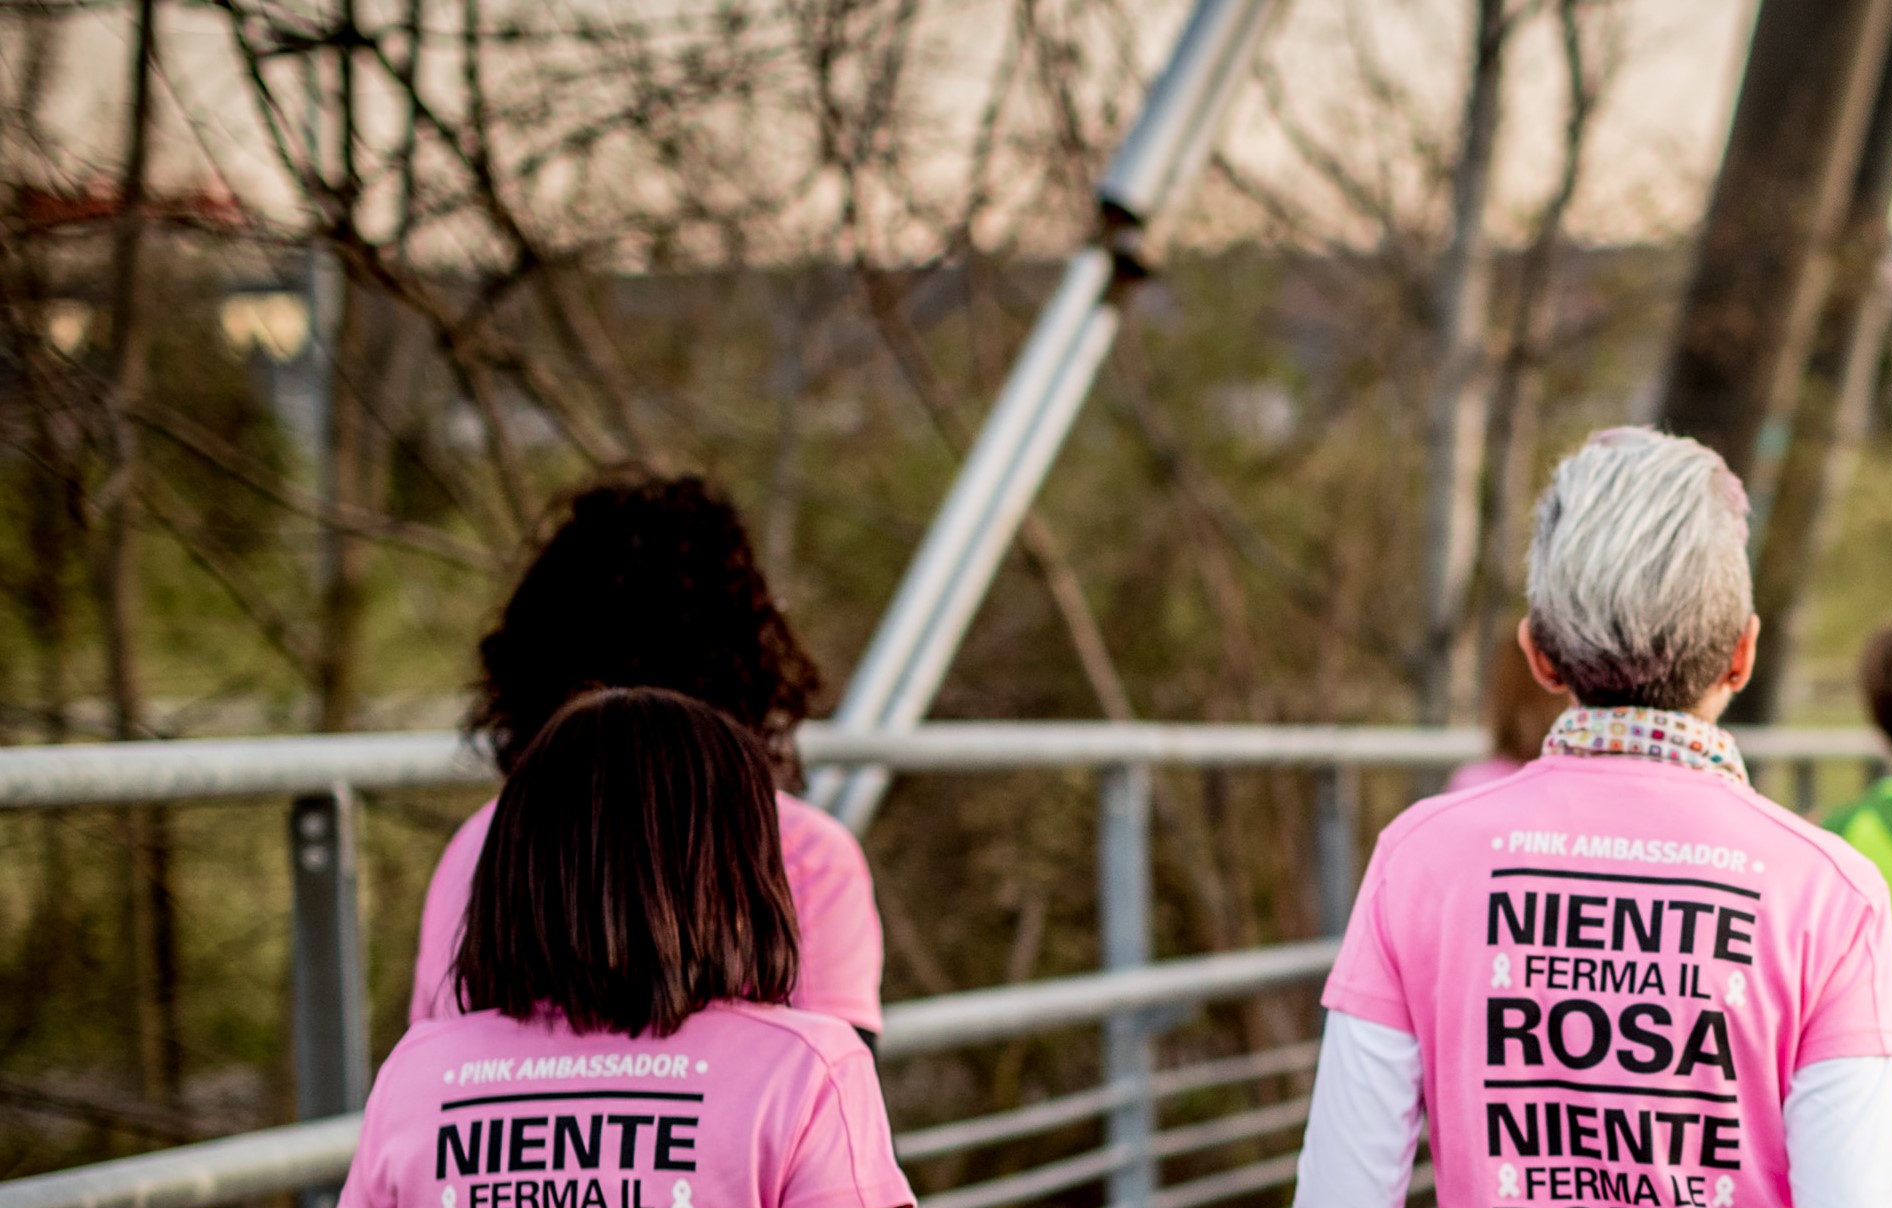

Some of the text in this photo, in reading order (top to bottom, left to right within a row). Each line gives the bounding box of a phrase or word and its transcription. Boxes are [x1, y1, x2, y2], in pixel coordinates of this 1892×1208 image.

[1509, 831, 1747, 872] PINK AMBASSADOR
[1487, 891, 1756, 966] NIENTE
[1525, 956, 1711, 1000] FERMA IL
[1486, 997, 1737, 1081] ROSA
[459, 1054, 688, 1084] PINK AMBASSADOR
[436, 1114, 700, 1179] NIENTE
[1486, 1103, 1741, 1170] NIENTE
[1525, 1167, 1706, 1208] FERMA LE
